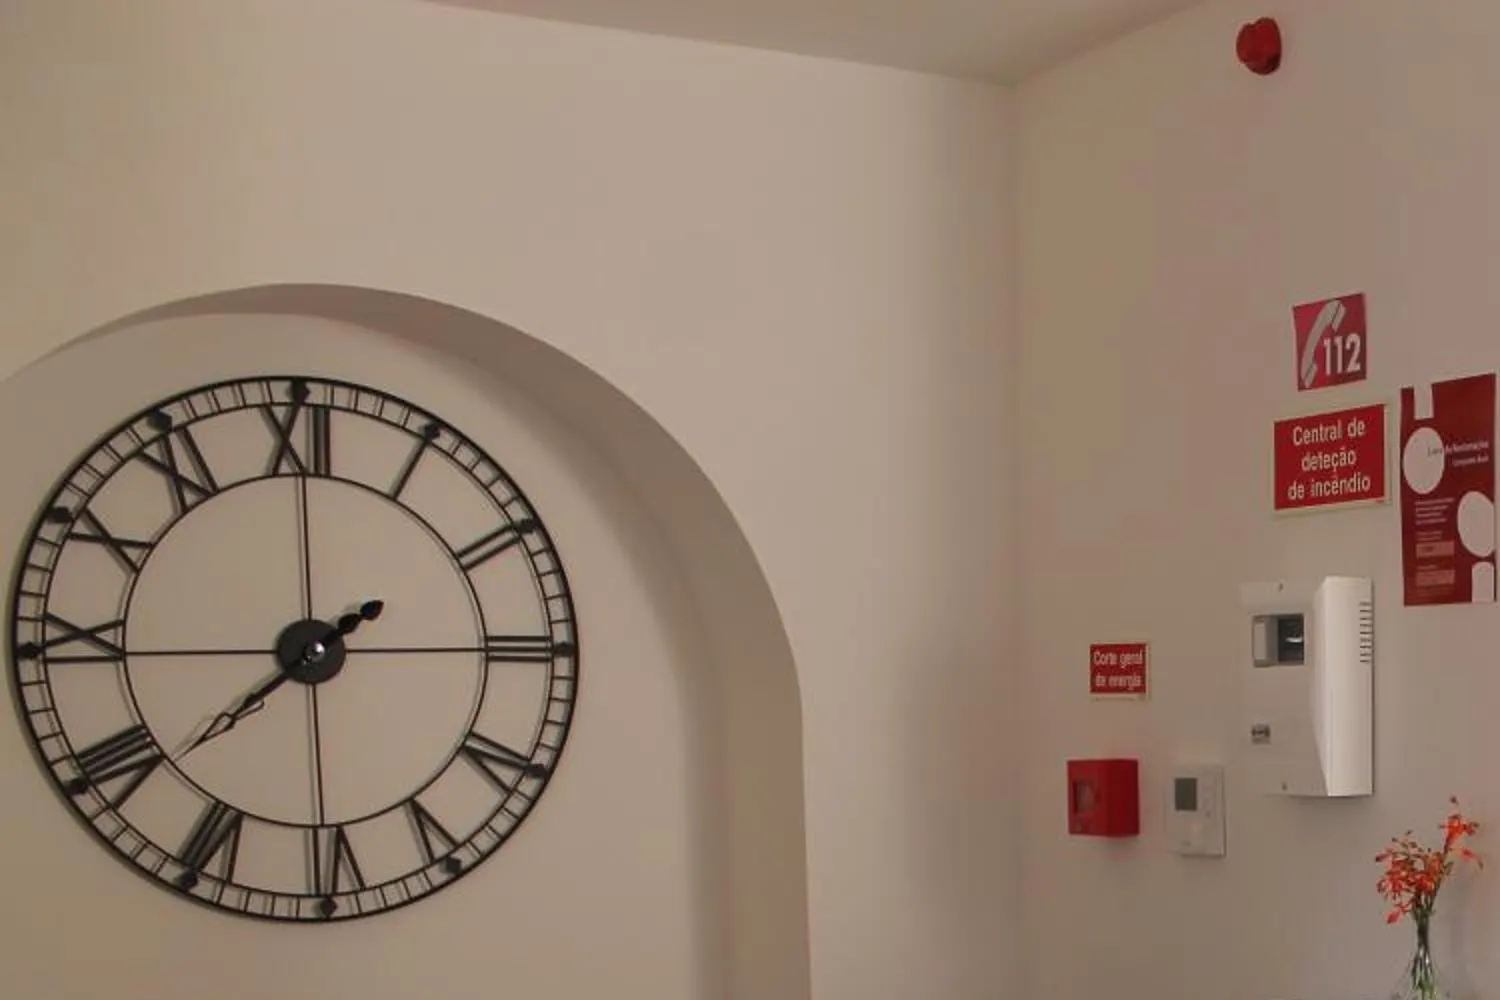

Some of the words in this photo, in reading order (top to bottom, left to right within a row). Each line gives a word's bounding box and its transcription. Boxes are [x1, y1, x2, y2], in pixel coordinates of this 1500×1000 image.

[1323, 333, 1361, 376] 112
[1293, 420, 1343, 446] Central
[1347, 417, 1366, 438] de
[1301, 446, 1357, 472] deteção
[1287, 480, 1305, 500] de
[1310, 473, 1371, 497] incêndio
